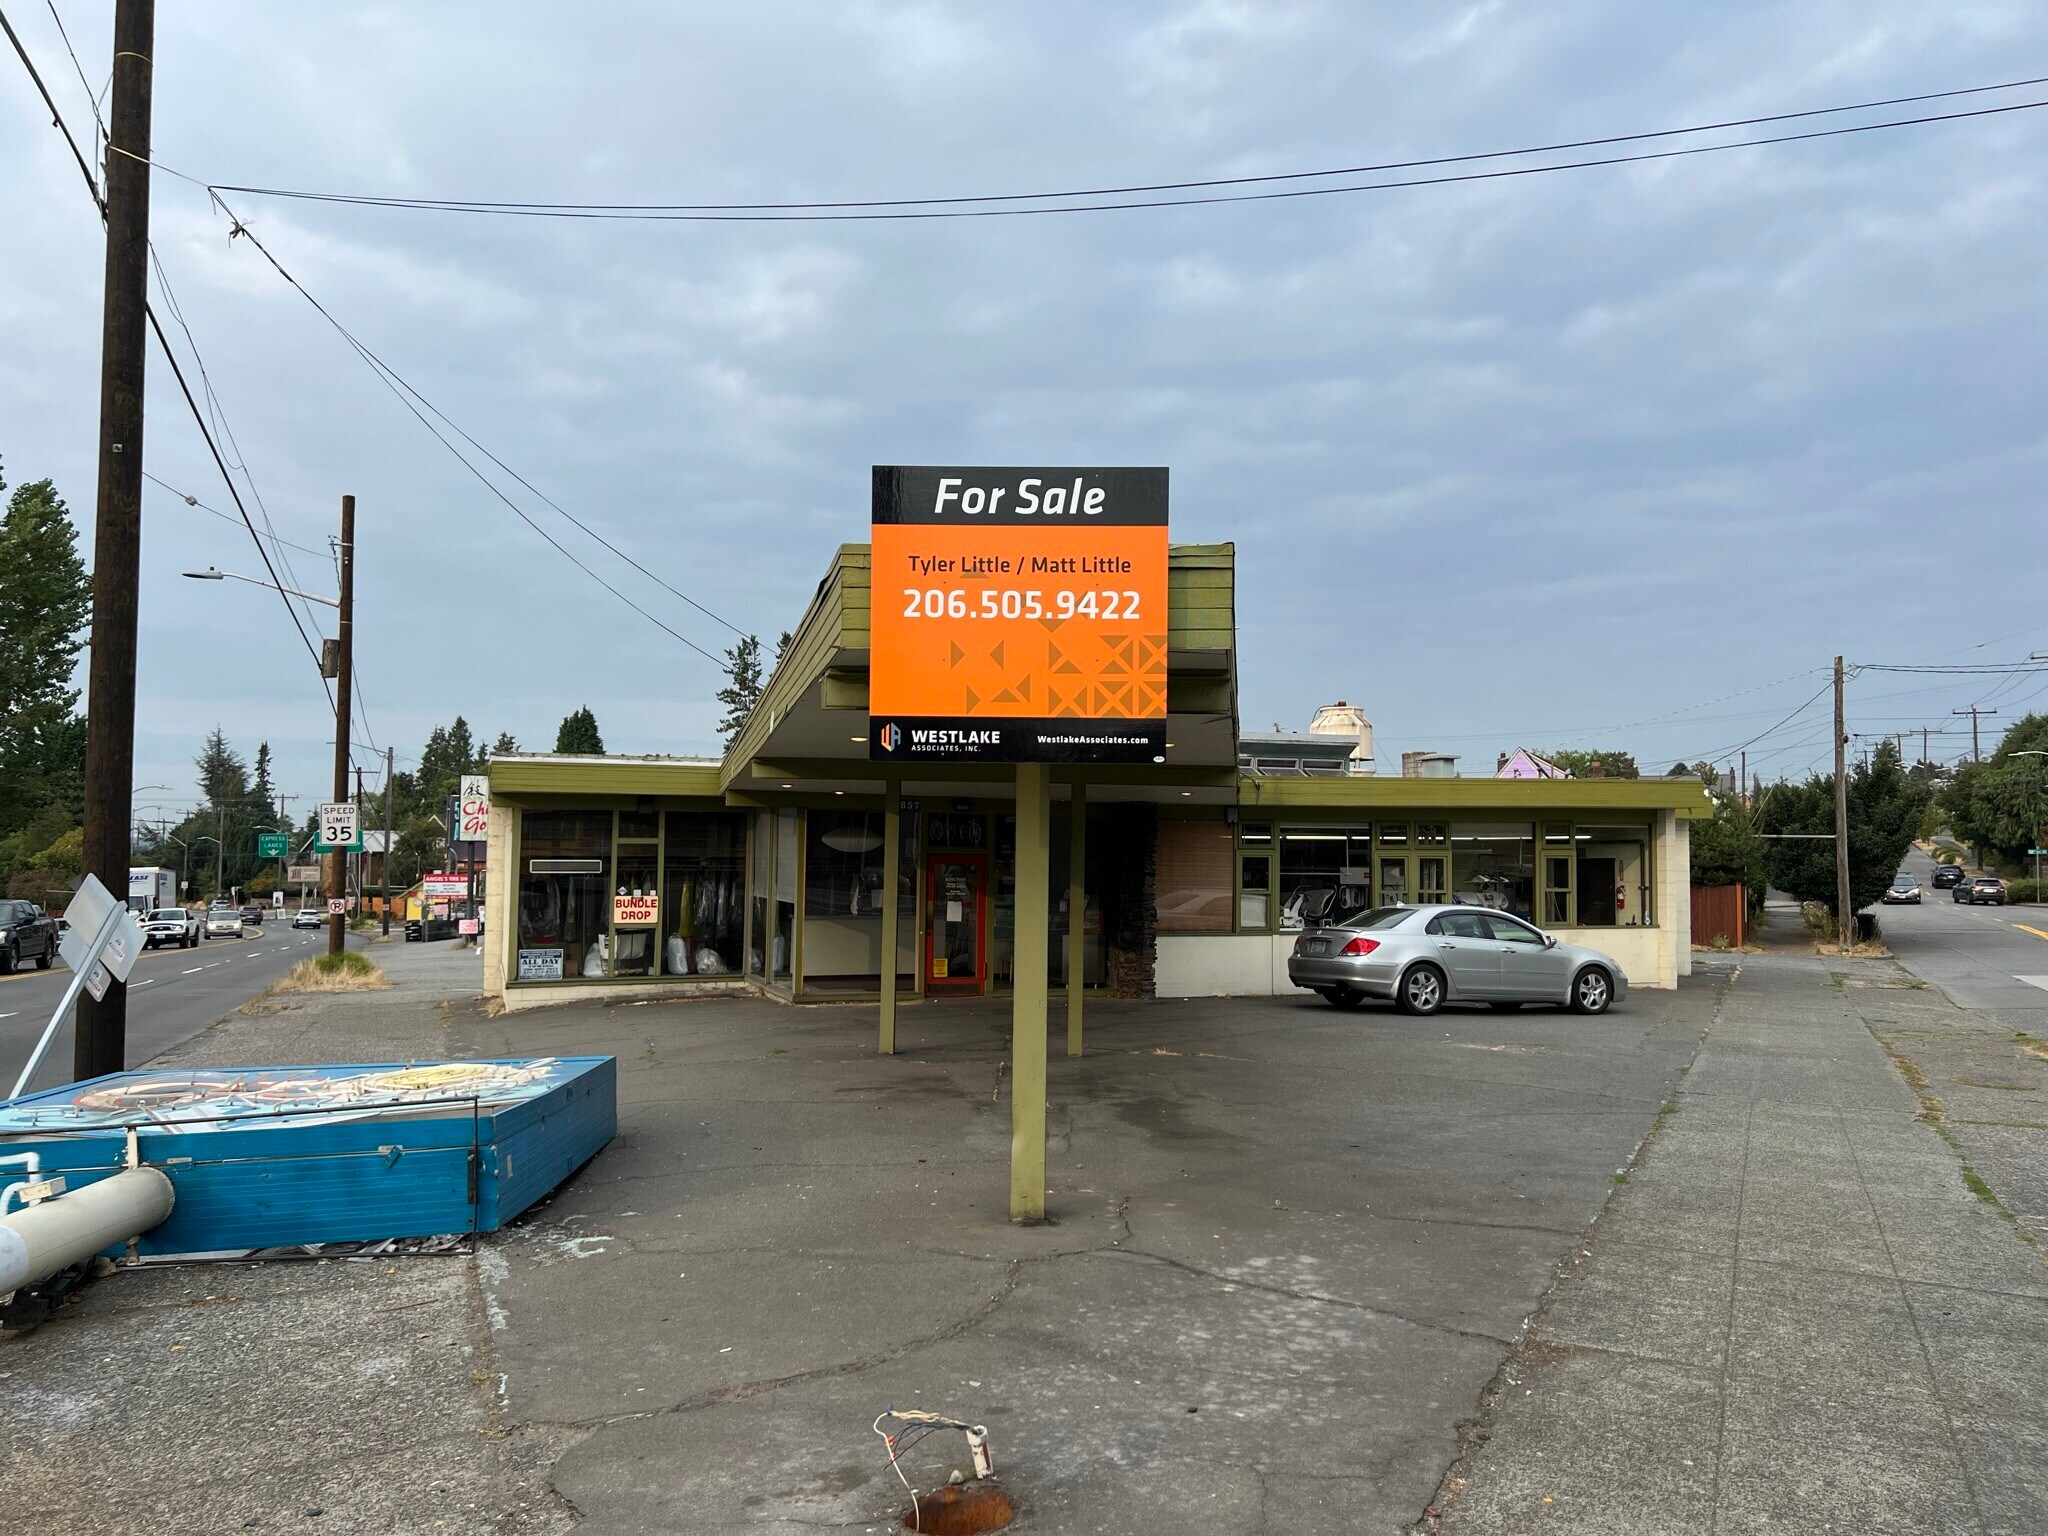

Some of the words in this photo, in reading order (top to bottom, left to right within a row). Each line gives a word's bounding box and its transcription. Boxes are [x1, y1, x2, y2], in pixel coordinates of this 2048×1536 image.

[934, 478, 1005, 514] For
[1015, 477, 1106, 515] Sale
[908, 555, 956, 576] Tyler
[961, 556, 1010, 573] Little
[1017, 557, 1025, 575] /
[1031, 556, 1076, 573] Matt
[1082, 557, 1131, 573] Little
[903, 588, 1140, 619] 206.505.9422
[911, 730, 1001, 744] WESTLAKE
[1037, 735, 1149, 744] WestlakeAssociates.com
[323, 807, 355, 815] SPEED
[464, 817, 487, 835] Go
[326, 826, 352, 841] 35
[615, 899, 658, 908] BUNDLE
[621, 911, 651, 920] DROP
